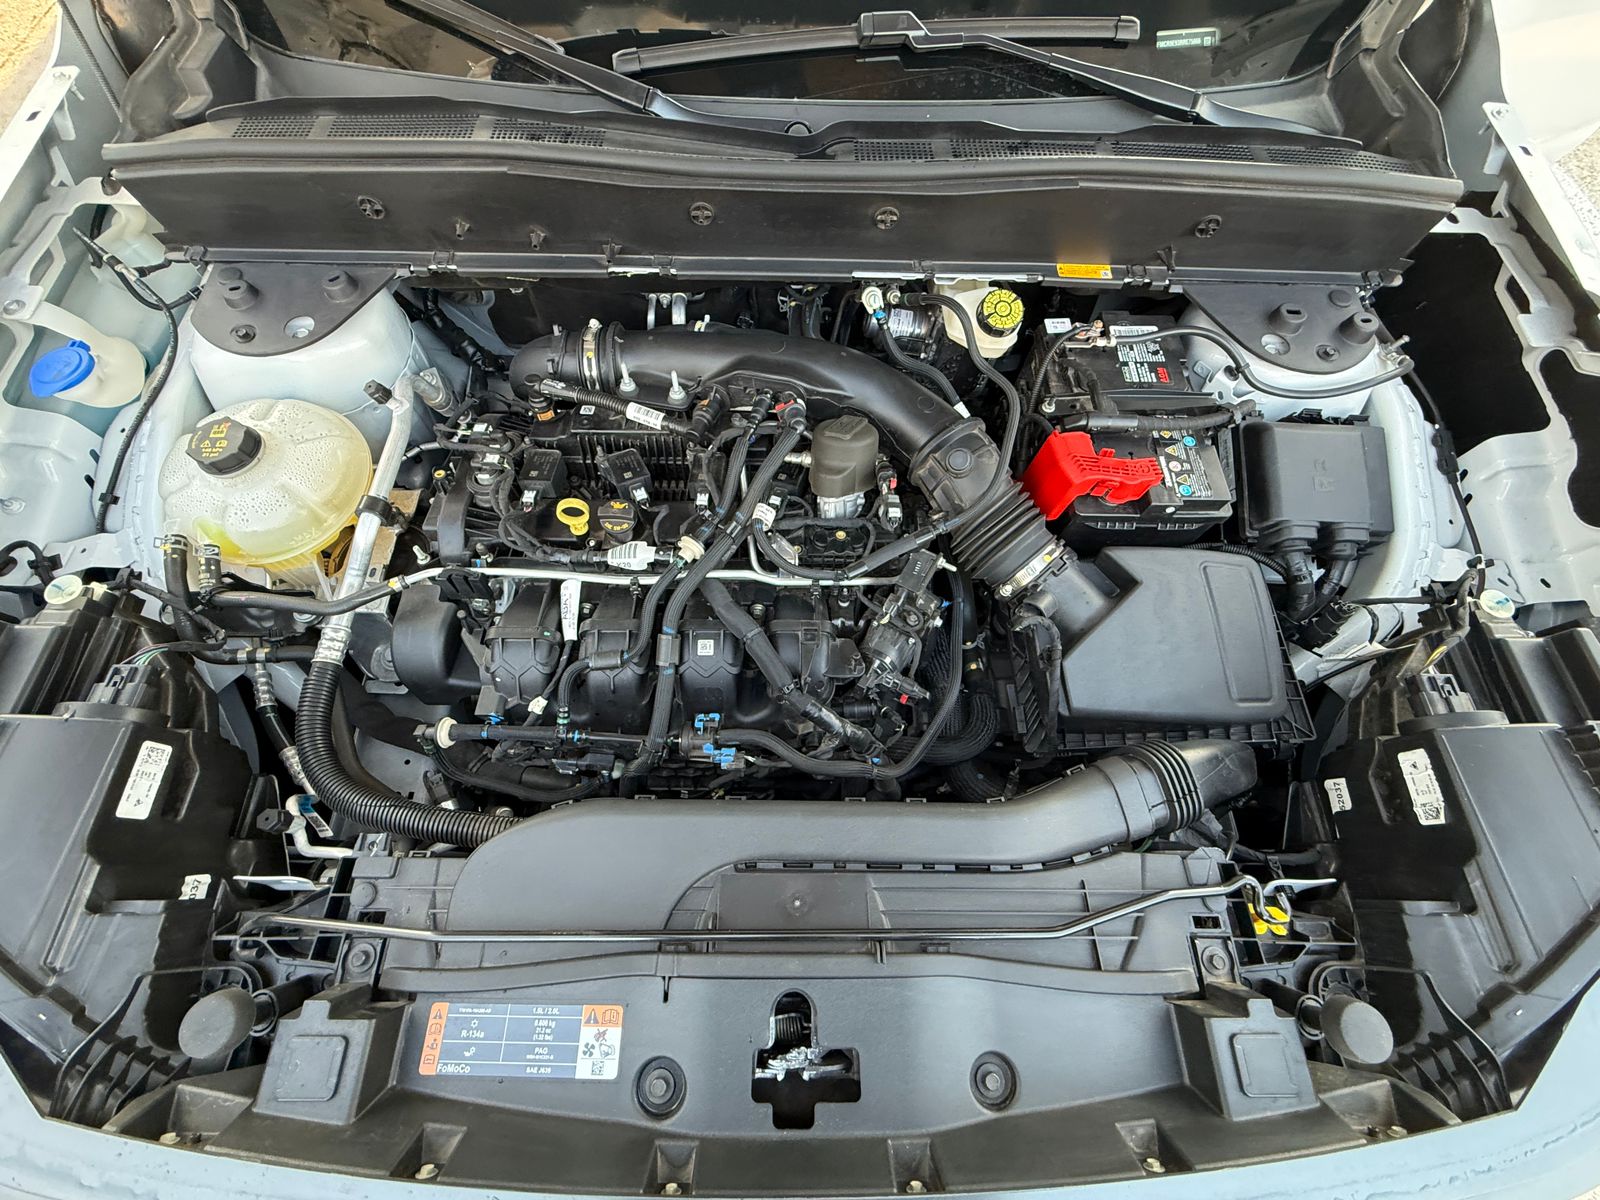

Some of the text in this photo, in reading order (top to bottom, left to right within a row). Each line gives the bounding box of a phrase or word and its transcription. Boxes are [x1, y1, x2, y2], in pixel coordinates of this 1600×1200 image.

[549, 1020, 556, 1029] kg
[461, 1030, 485, 1039] R-134a
[437, 1064, 471, 1074] FoMoCo
